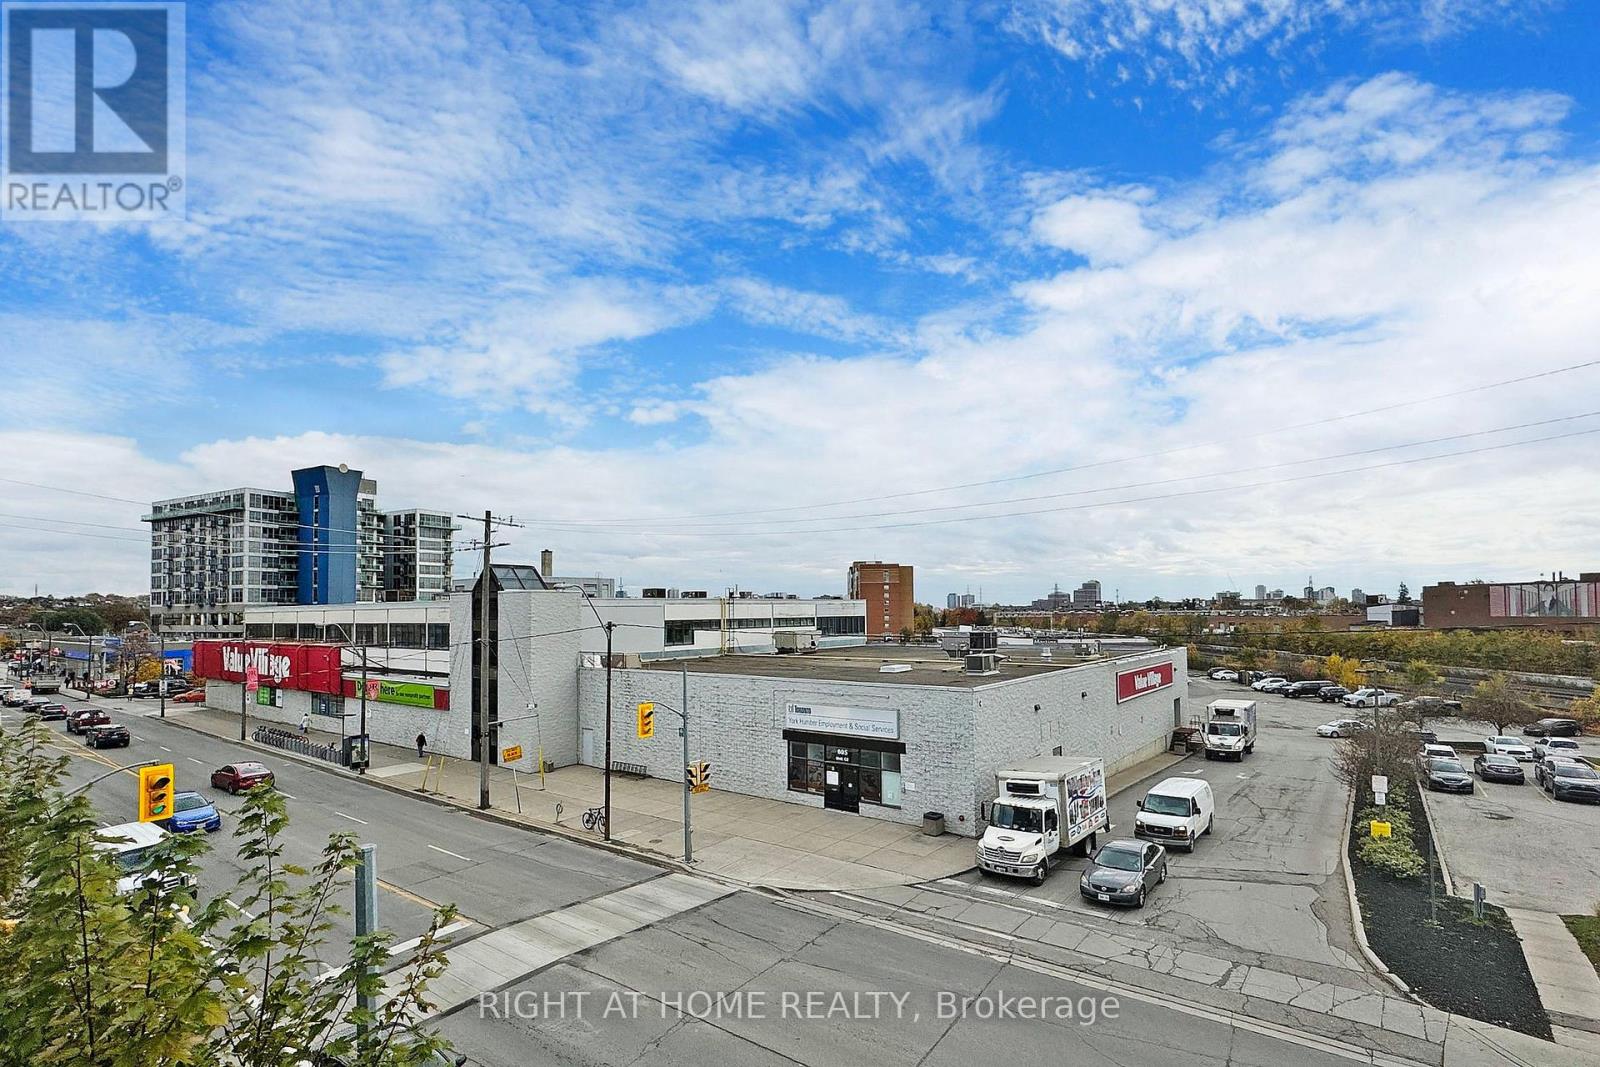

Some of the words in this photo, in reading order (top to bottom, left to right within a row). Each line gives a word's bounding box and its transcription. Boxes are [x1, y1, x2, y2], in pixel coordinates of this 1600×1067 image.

[222, 646, 251, 674] Value
[250, 647, 291, 683] Village
[1134, 674, 1148, 690] Value
[799, 719, 818, 727] Humber
[819, 721, 848, 730] Employment
[849, 722, 854, 730] &
[854, 722, 871, 732] Social
[871, 725, 894, 734] Services
